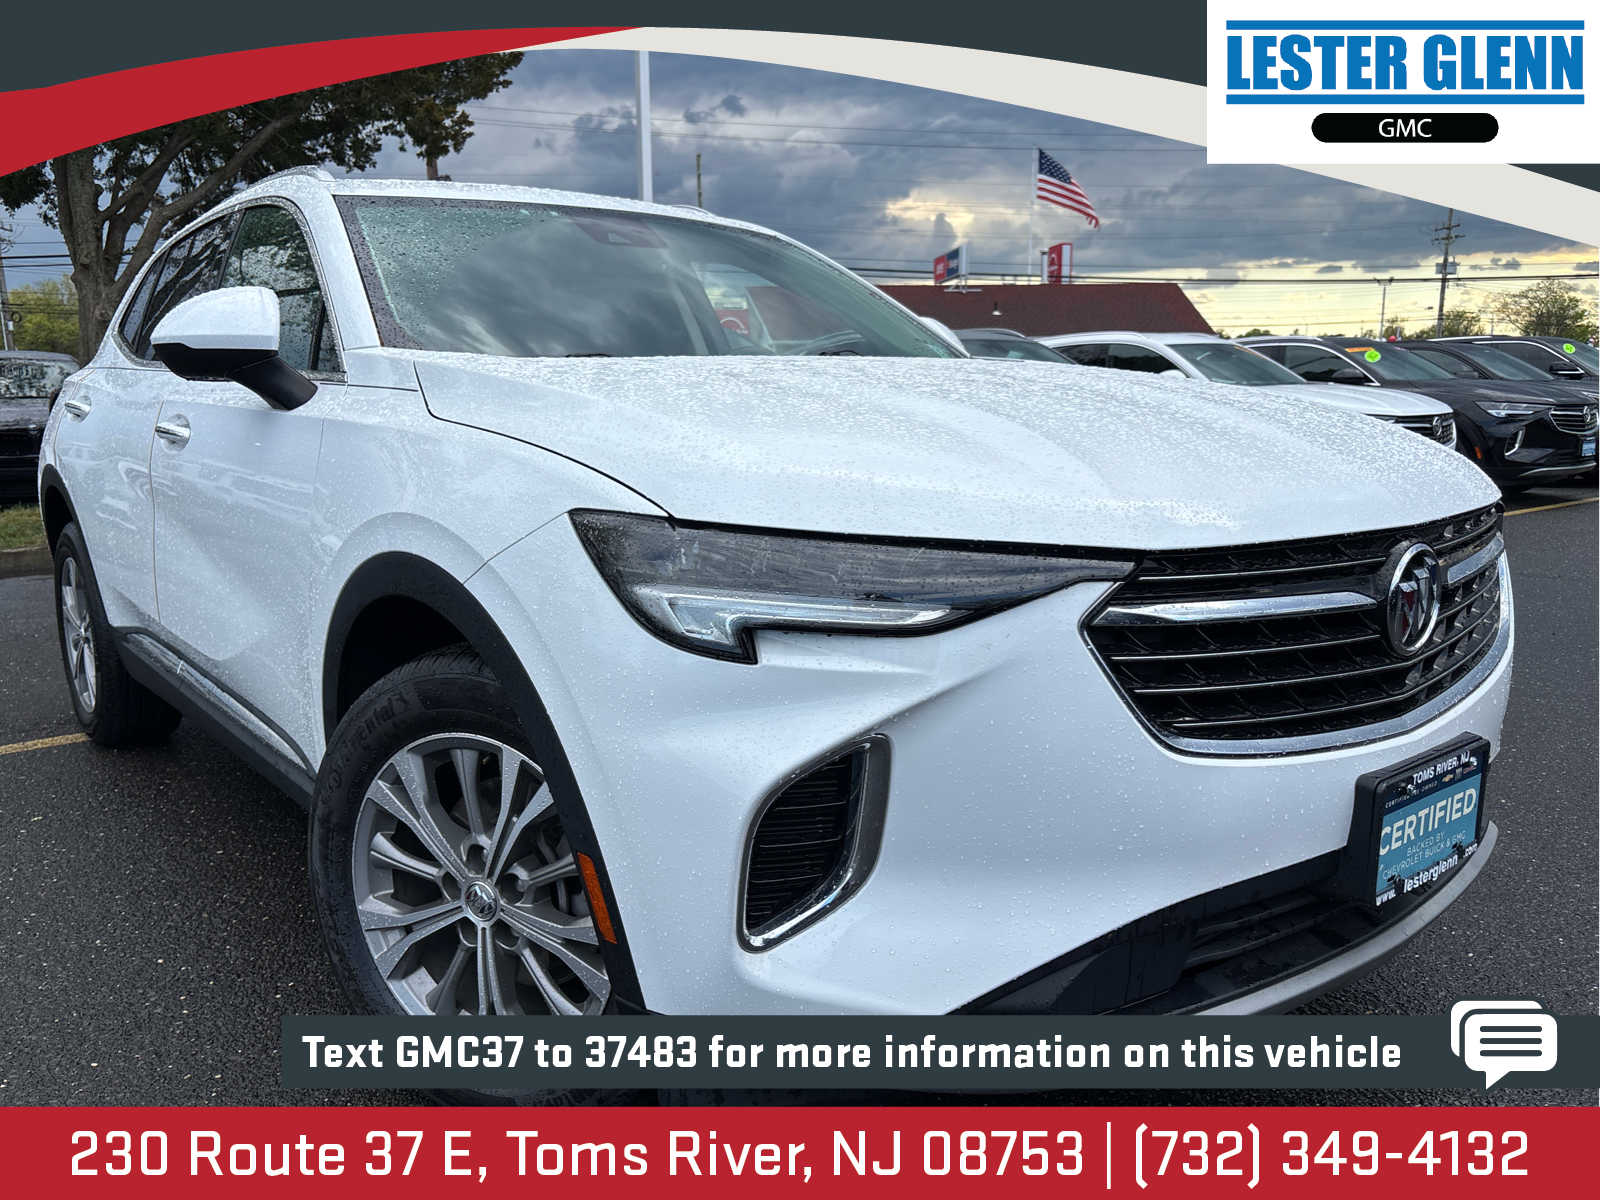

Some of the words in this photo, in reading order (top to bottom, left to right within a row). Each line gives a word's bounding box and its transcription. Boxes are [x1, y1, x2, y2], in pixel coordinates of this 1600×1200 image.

[1412, 766, 1435, 785] TOMS
[1436, 756, 1459, 775] RIVER,
[1460, 750, 1470, 765] NJ
[1379, 787, 1477, 856] CERTIFIED
[1382, 853, 1422, 880] CHEVROLET
[1425, 841, 1444, 858] BUICK
[1407, 836, 1434, 857] BACKED
[1436, 831, 1445, 842] BY
[1403, 854, 1458, 893] lesterglenn
